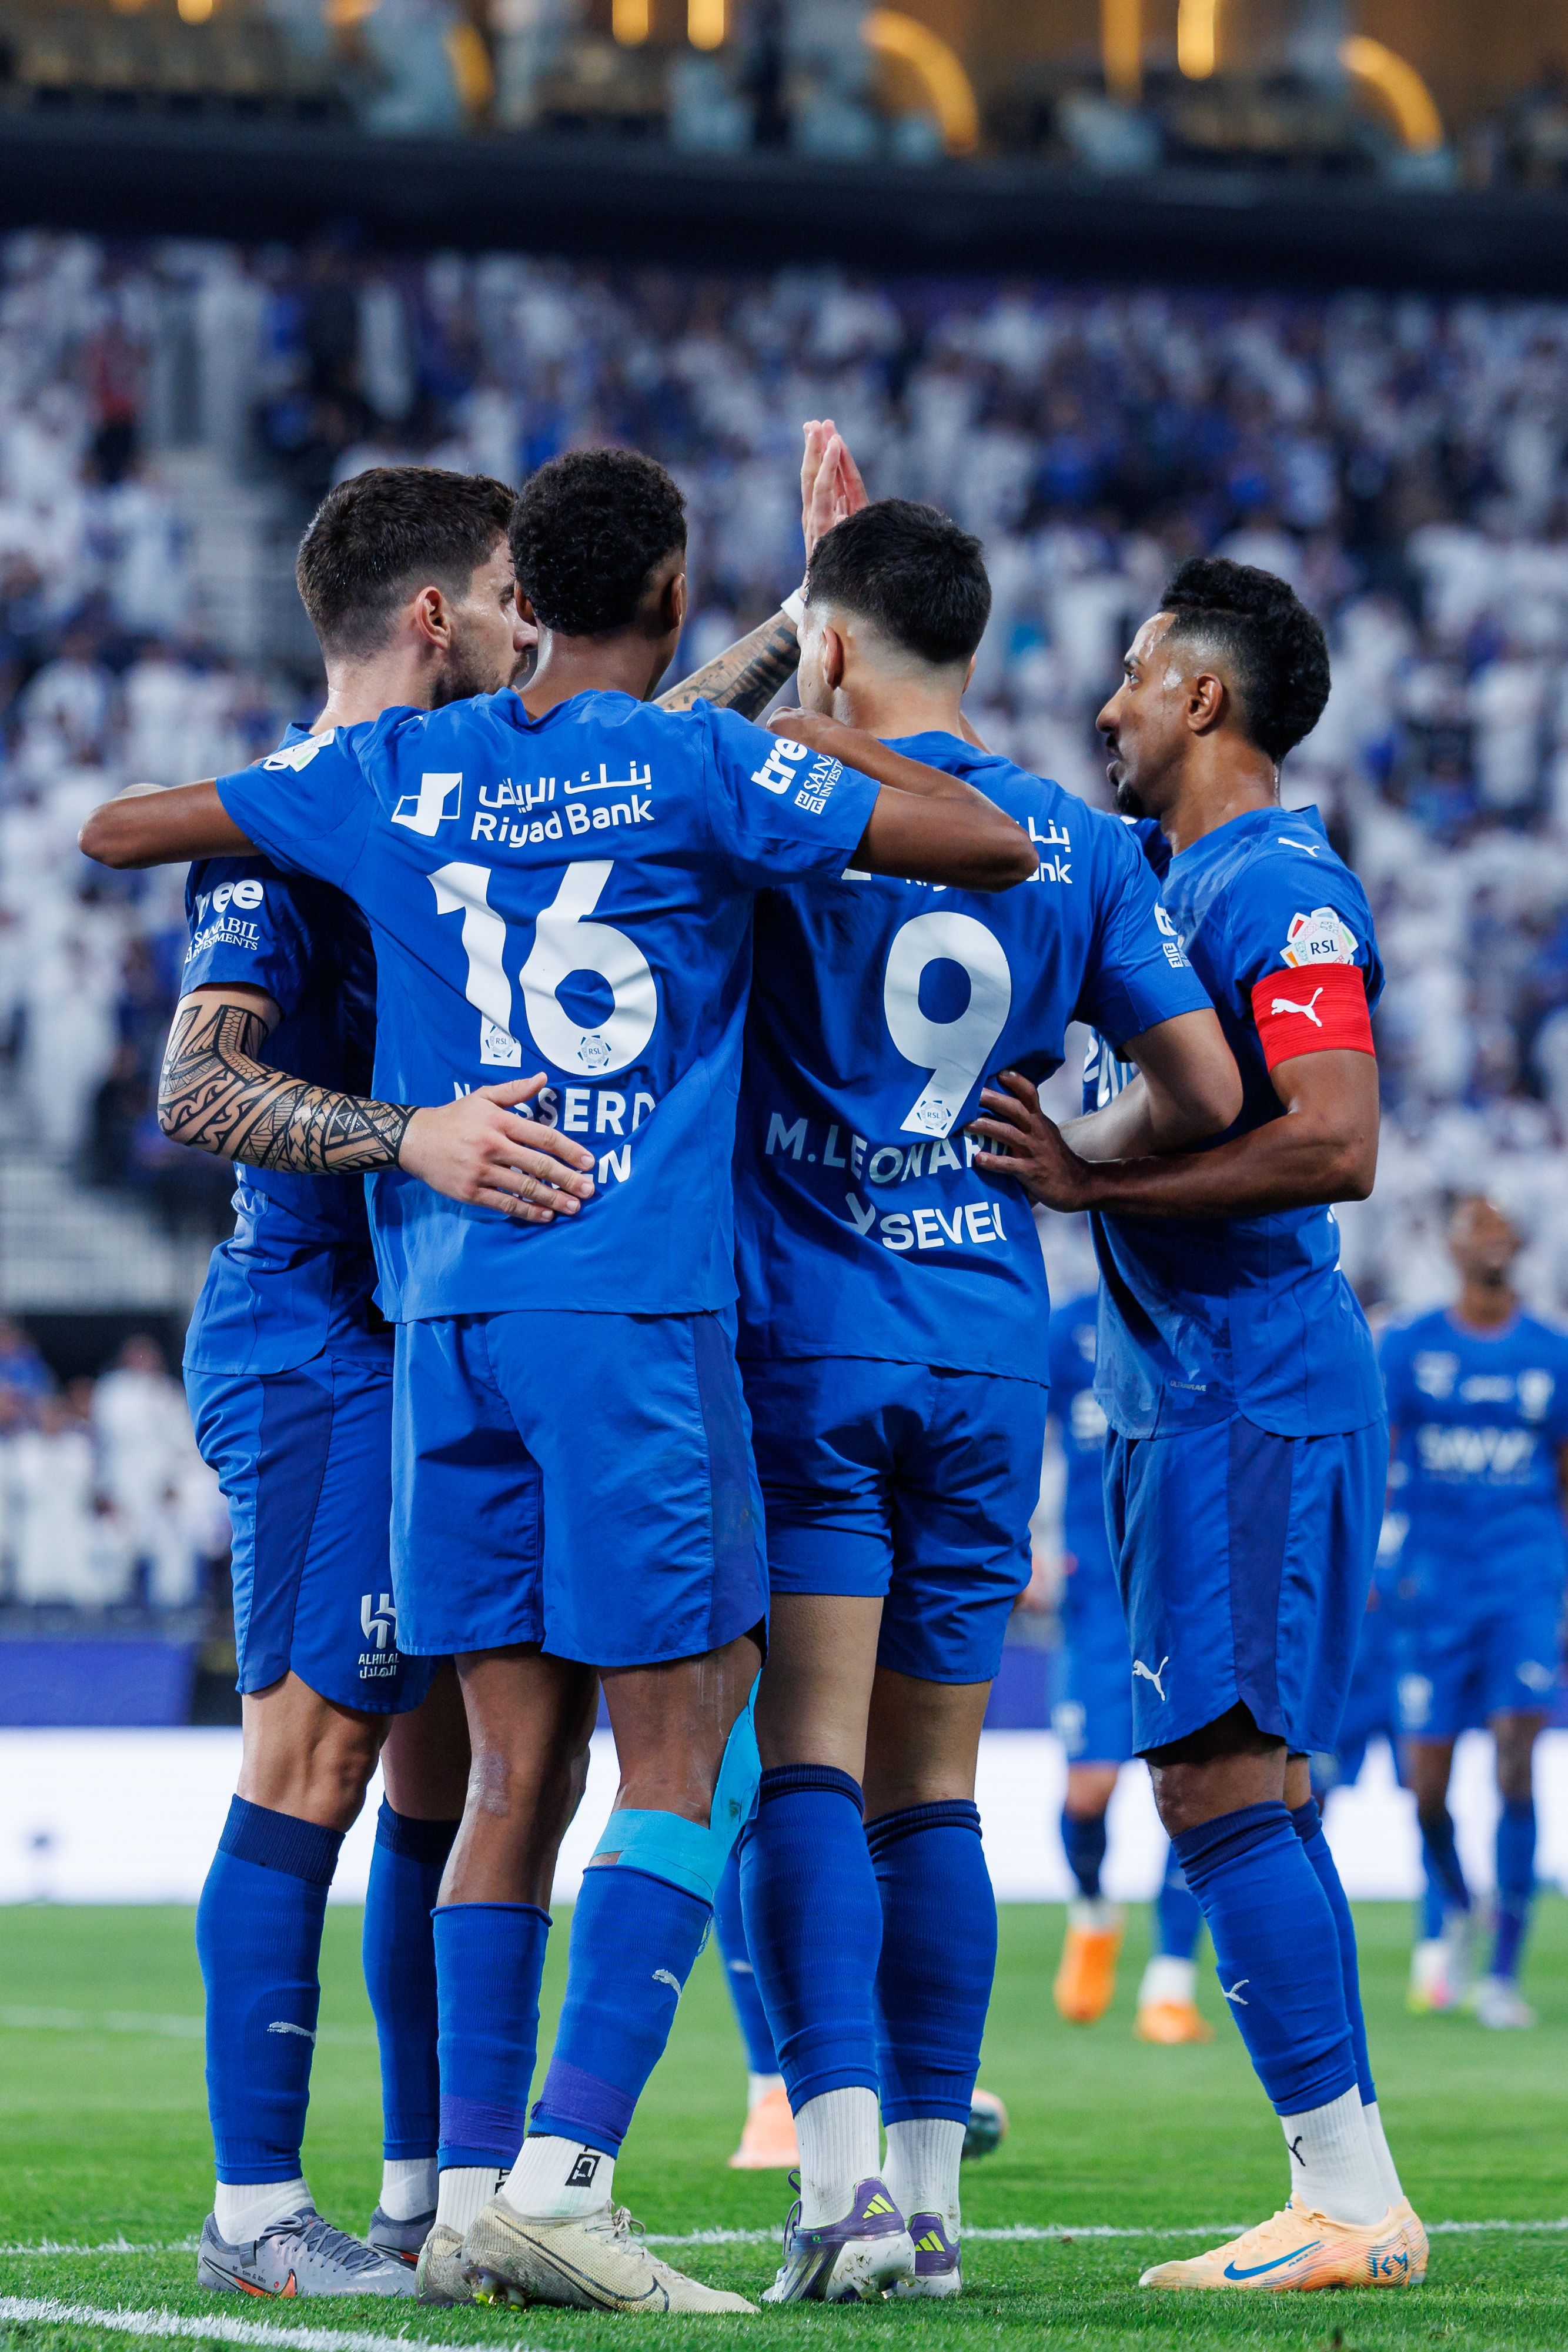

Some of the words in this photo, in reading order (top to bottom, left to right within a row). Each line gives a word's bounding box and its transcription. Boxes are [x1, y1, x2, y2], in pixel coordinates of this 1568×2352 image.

[751, 739, 808, 794] tre
[804, 754, 834, 794] SAN
[819, 760, 843, 797] INVEST
[470, 811, 563, 848] Riyad
[564, 794, 655, 836] Bank
[195, 879, 264, 925] ree
[426, 860, 657, 1076] 16
[1310, 940, 1338, 955] RSL
[884, 911, 1012, 1139] 9
